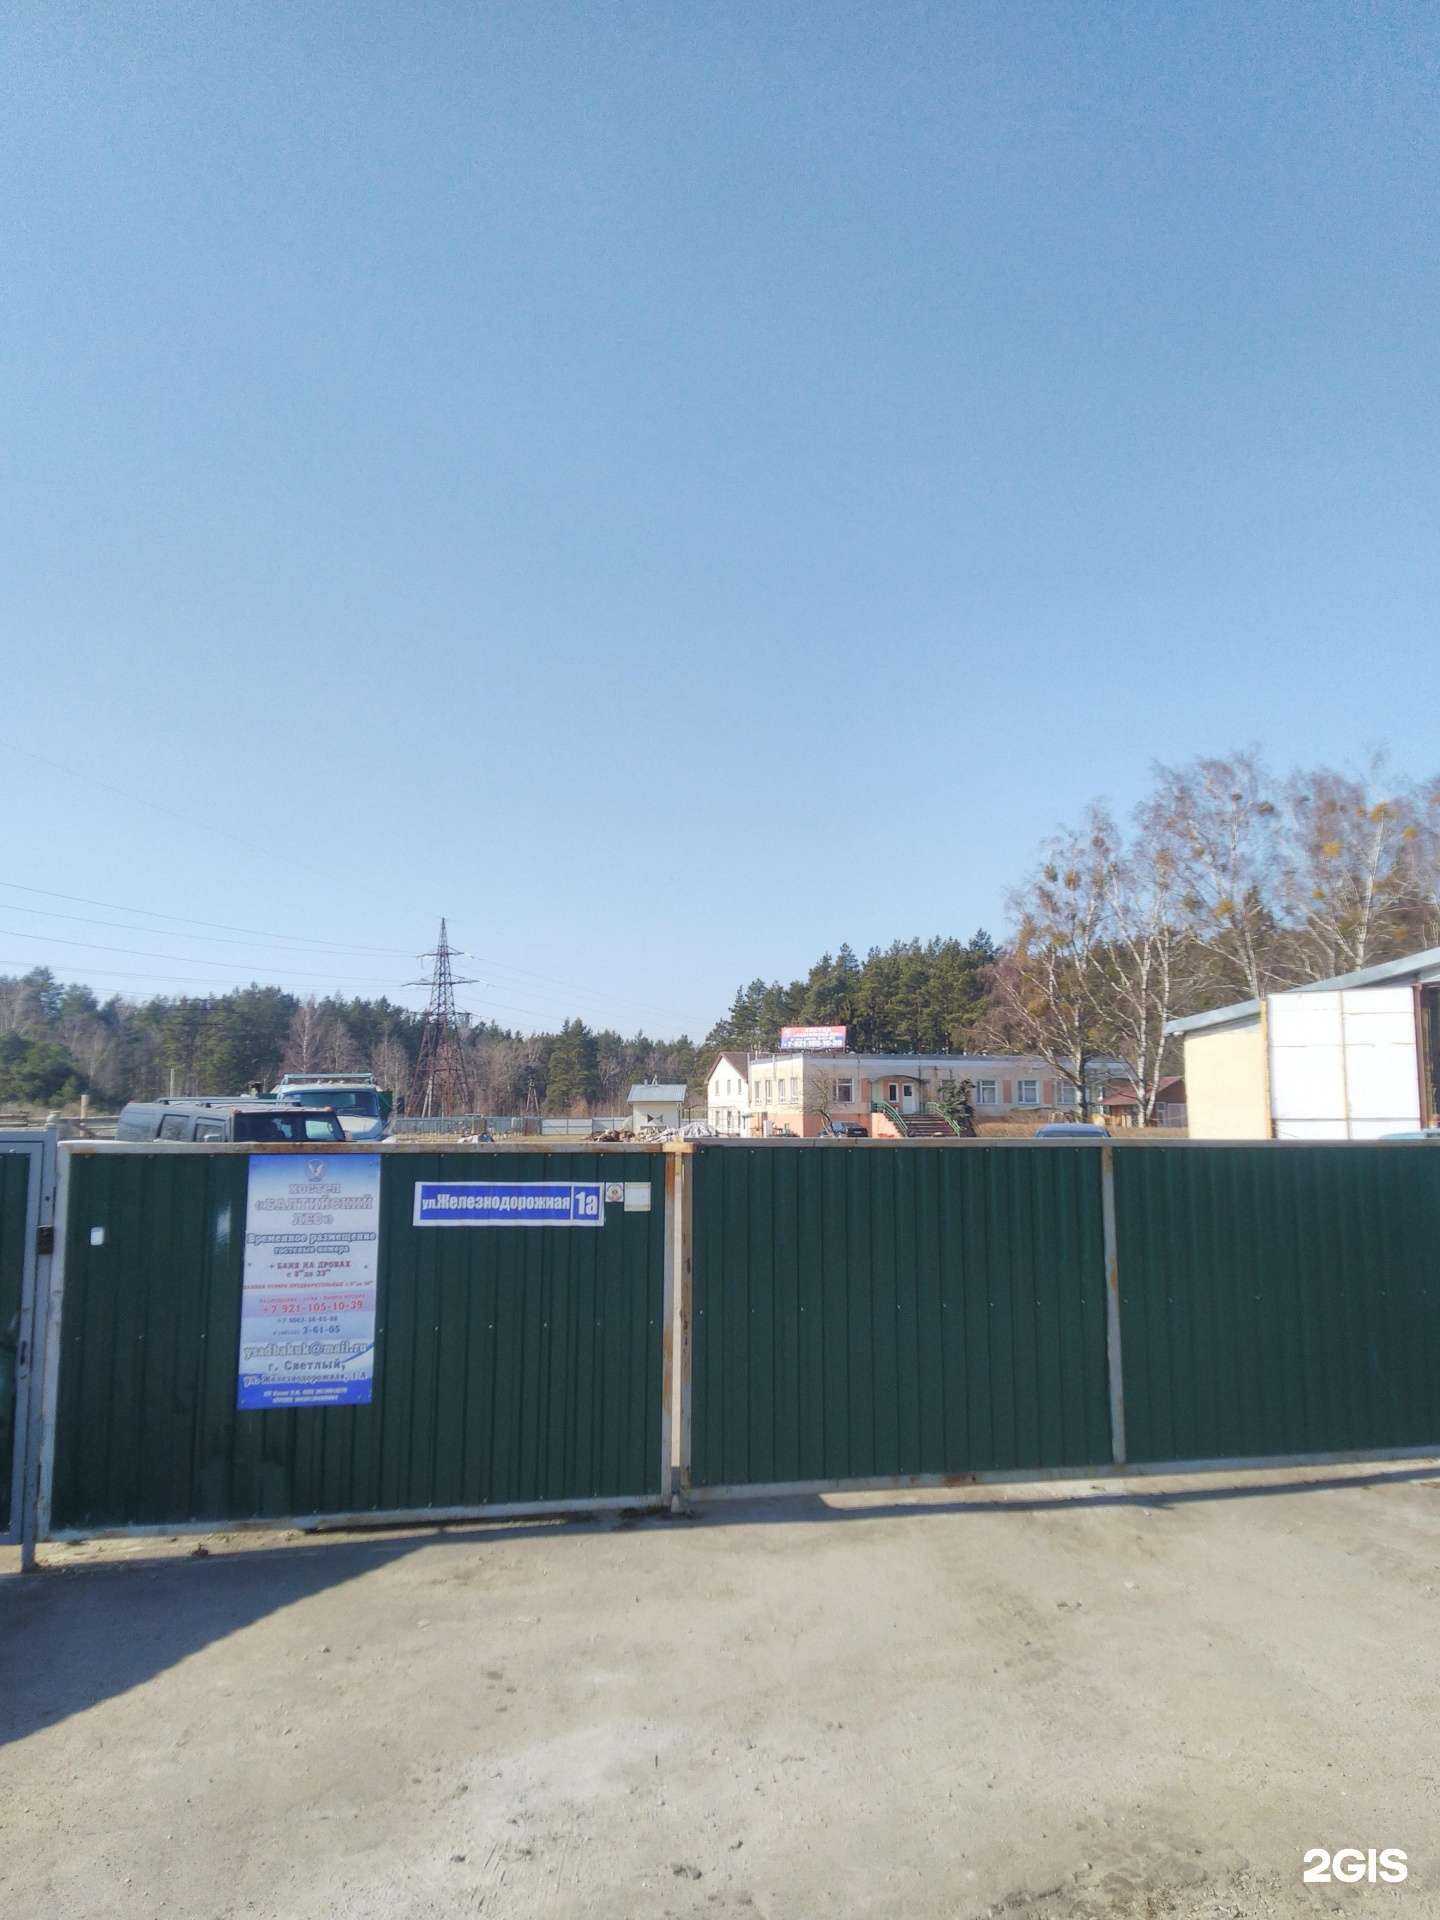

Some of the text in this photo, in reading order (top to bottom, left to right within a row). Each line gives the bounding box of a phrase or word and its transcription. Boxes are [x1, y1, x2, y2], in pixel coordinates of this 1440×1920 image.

[422, 1191, 598, 1215] ул.Железнодорожная 1а
[246, 1233, 307, 1246] Временное
